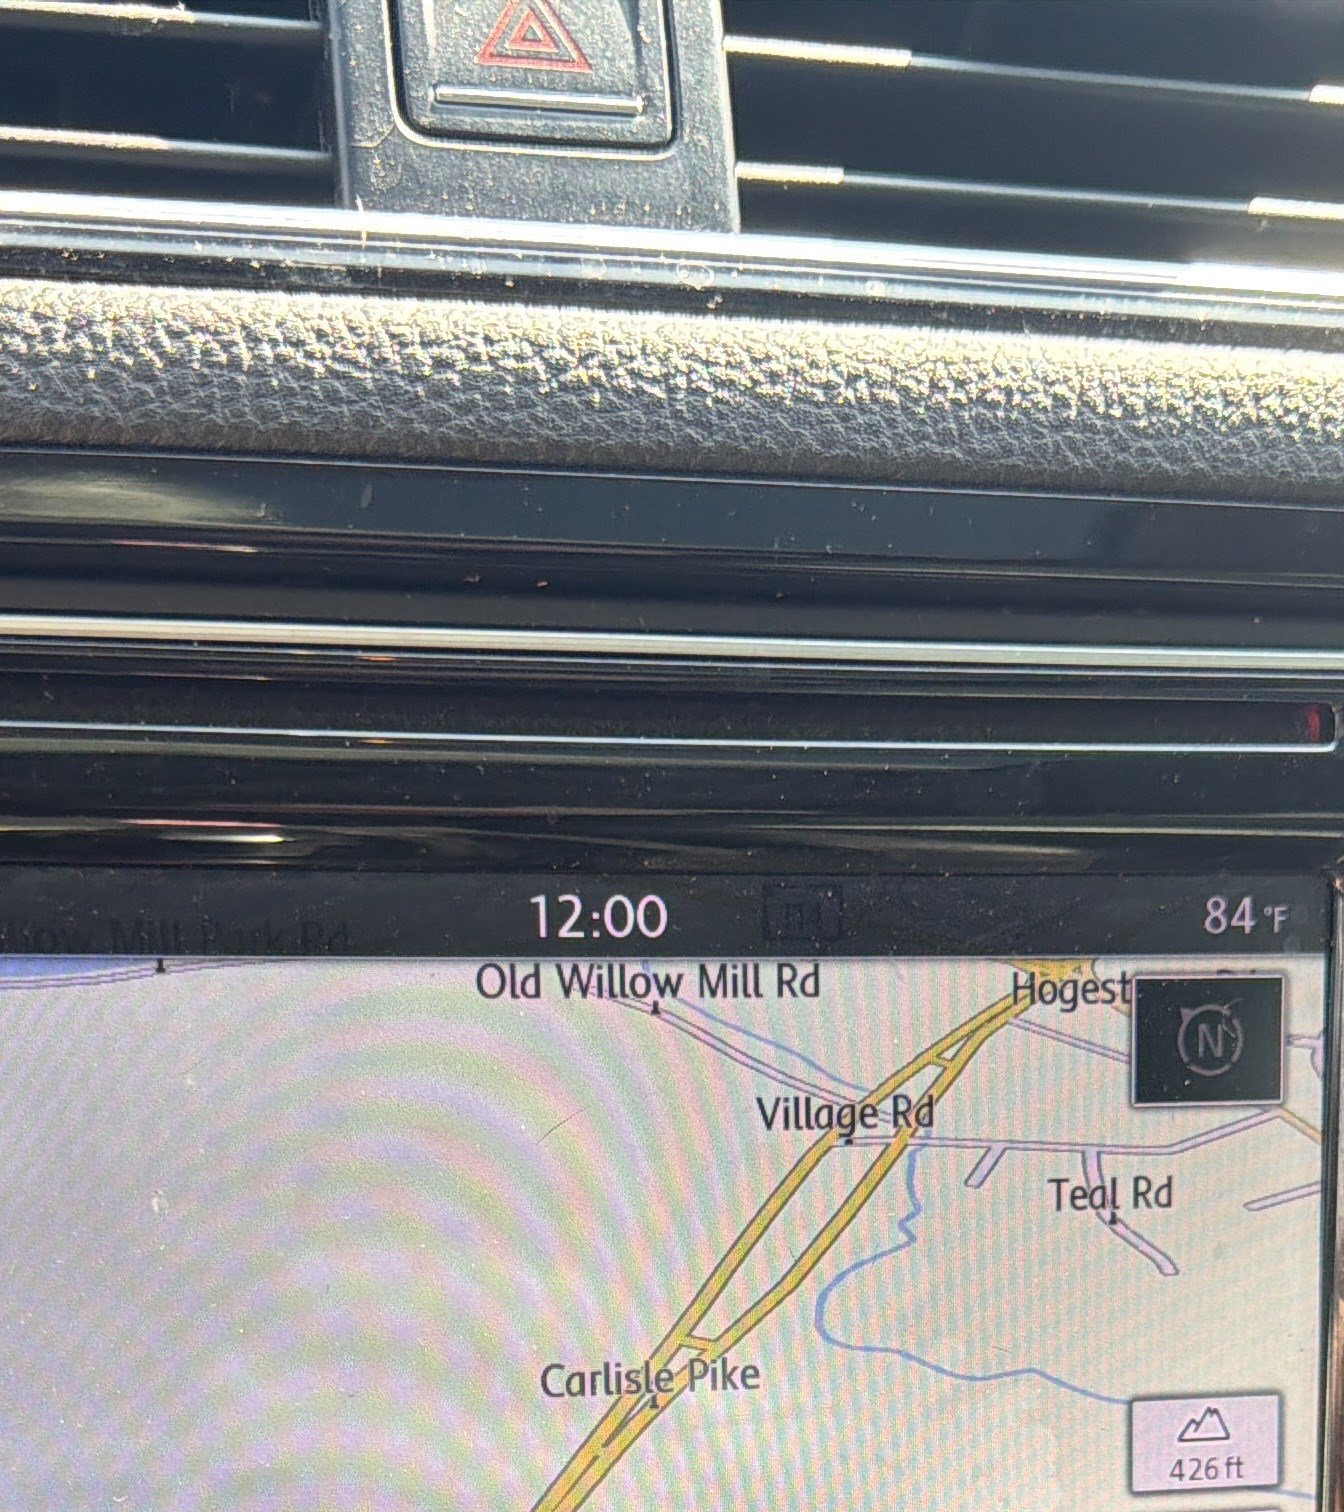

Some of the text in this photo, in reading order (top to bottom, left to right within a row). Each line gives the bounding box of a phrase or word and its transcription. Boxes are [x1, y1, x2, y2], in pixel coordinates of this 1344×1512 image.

[530, 894, 669, 938] 12:00
[476, 962, 821, 999] Old Willow Mill Rd
[1197, 1022, 1224, 1059] N
[756, 1094, 934, 1138] Village Rd
[1048, 1175, 1173, 1211] Teal Rd
[541, 1357, 761, 1397] Carlisle Pike
